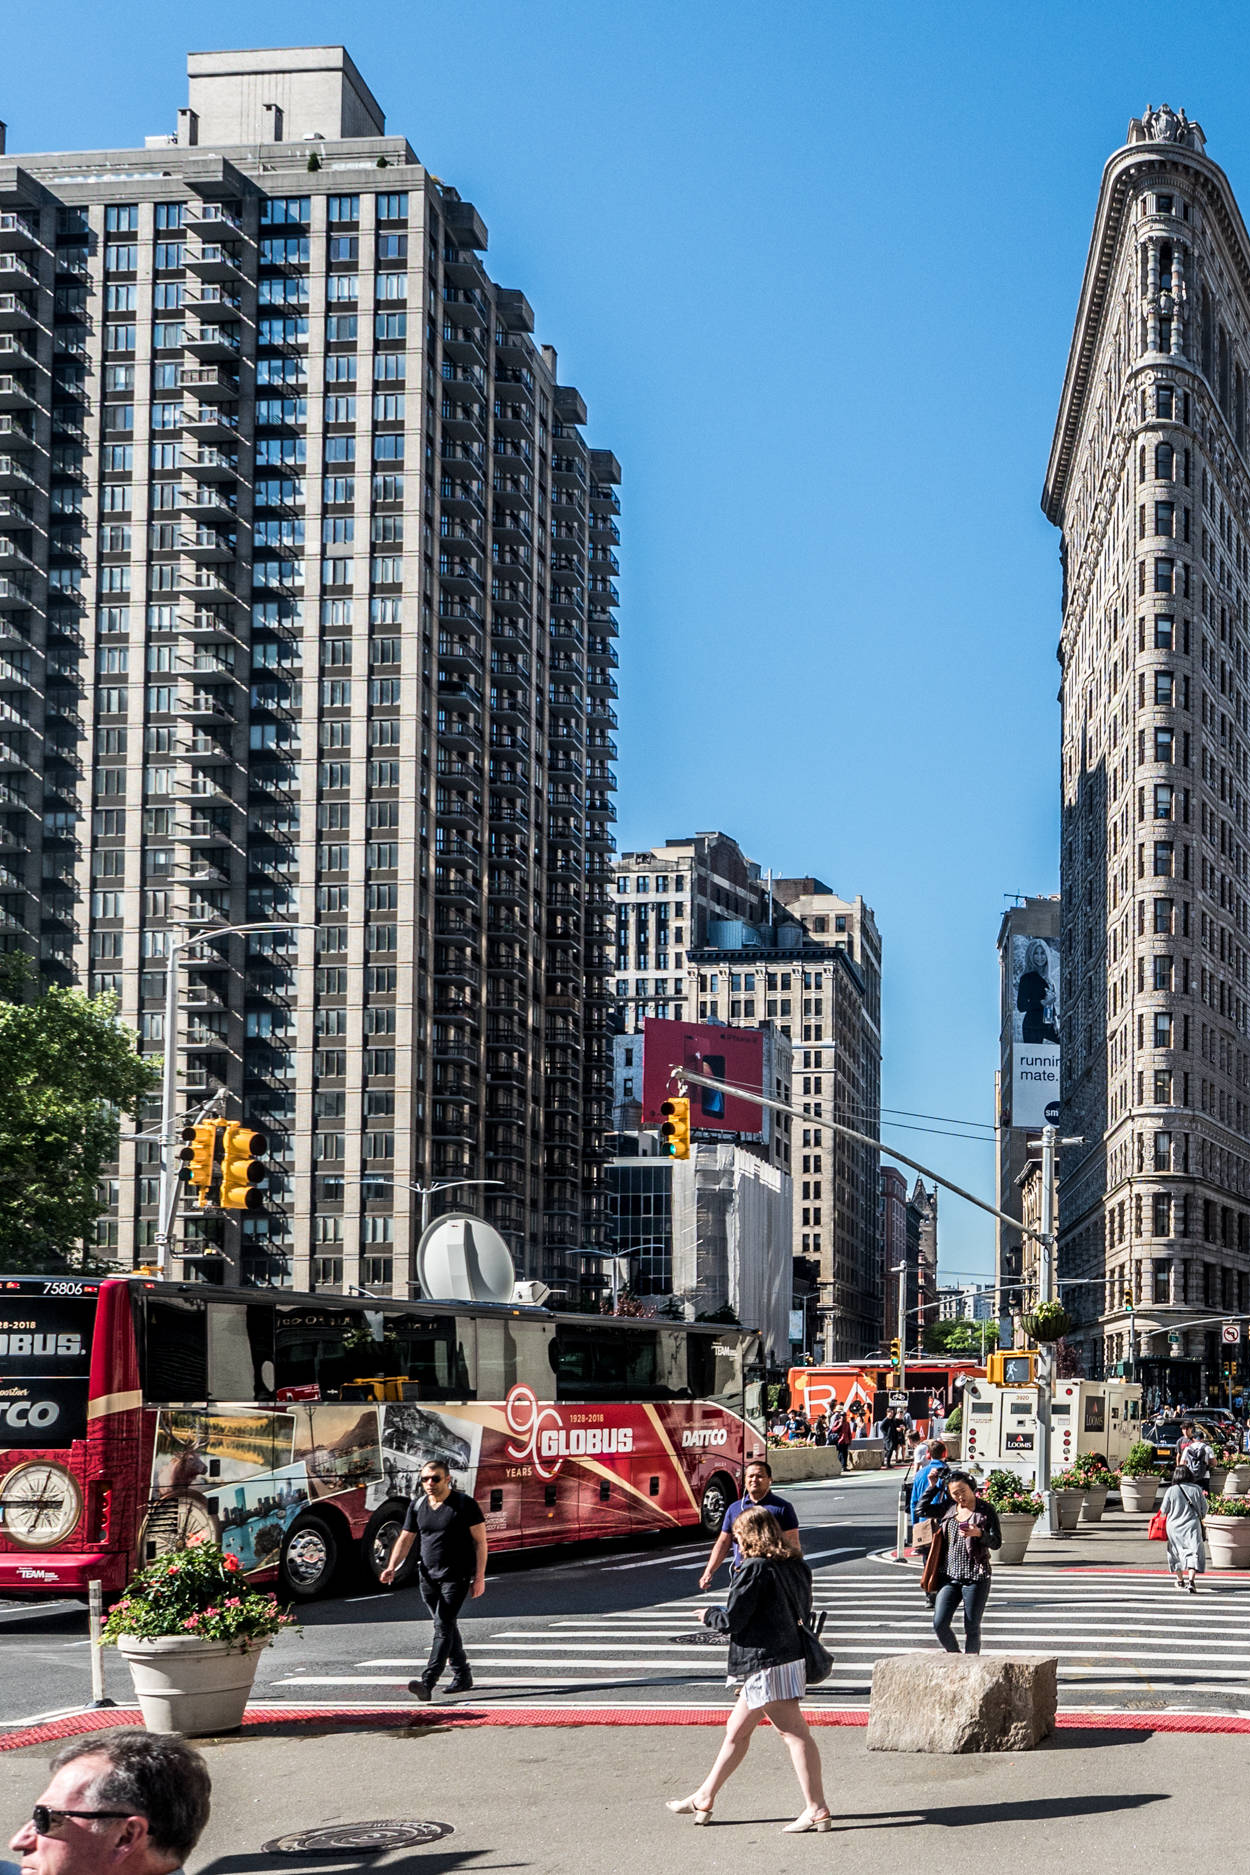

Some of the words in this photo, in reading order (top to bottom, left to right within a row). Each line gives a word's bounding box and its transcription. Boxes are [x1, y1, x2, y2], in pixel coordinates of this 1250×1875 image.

[1020, 1070, 1059, 1081] mate.
[42, 1282, 83, 1295] 75806
[569, 1414, 605, 1423] 1928-2018
[1086, 1414, 1104, 1426] LOOMIS
[541, 1428, 633, 1456] GLOBUS
[682, 1428, 728, 1448] DATTCO
[505, 1466, 533, 1478] YEARS
[21, 1570, 45, 1579] TEAM
